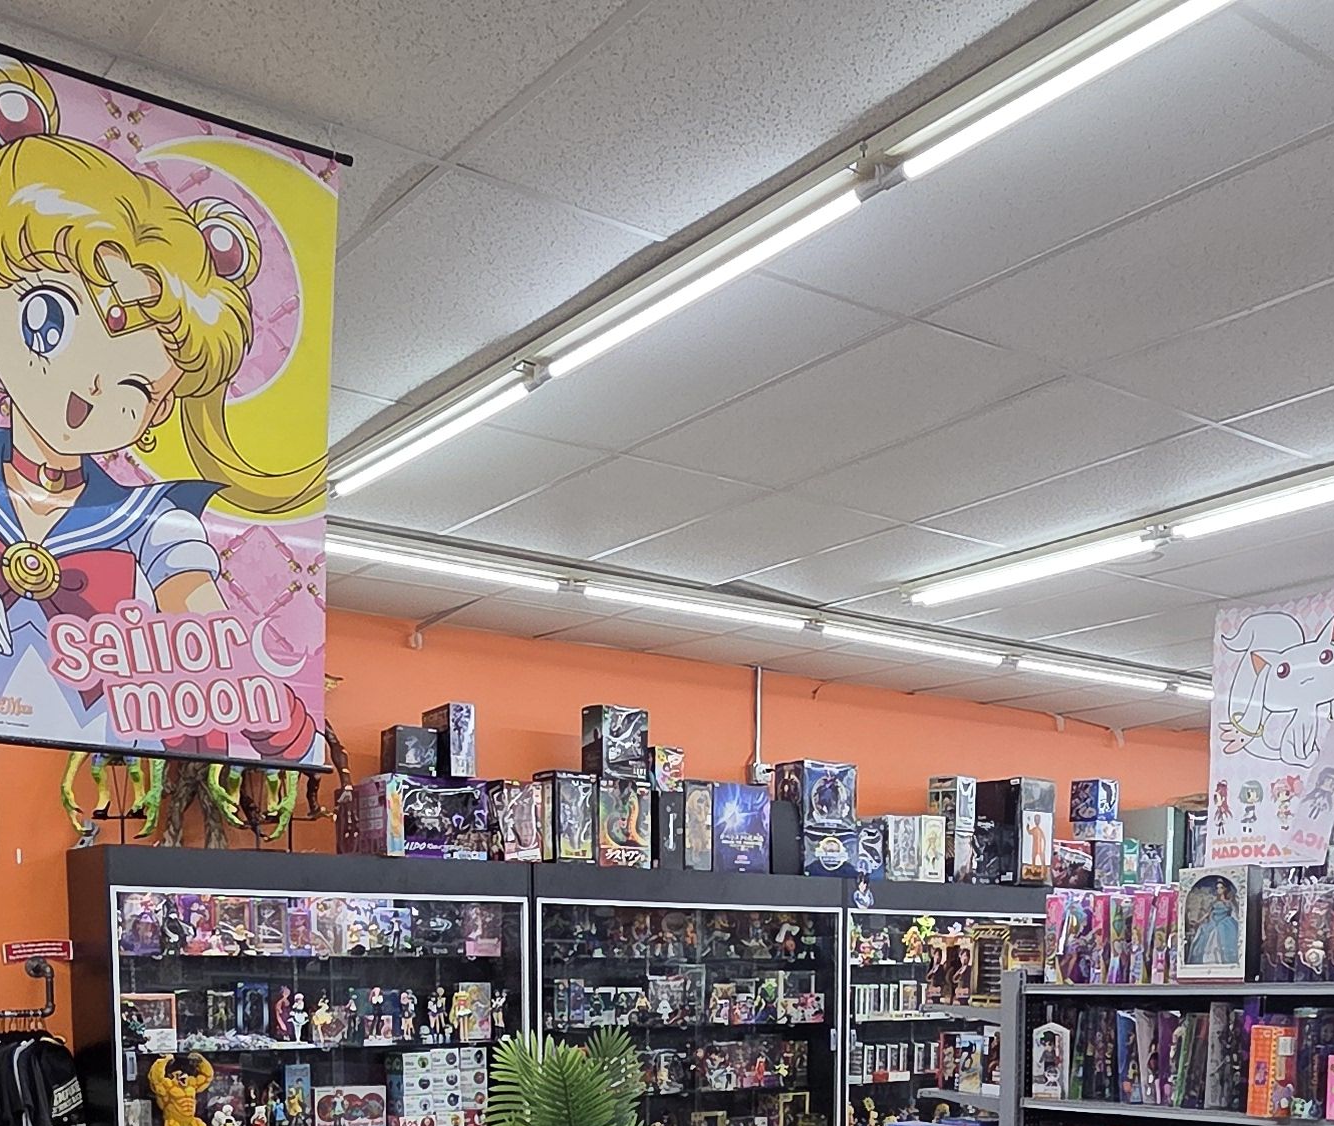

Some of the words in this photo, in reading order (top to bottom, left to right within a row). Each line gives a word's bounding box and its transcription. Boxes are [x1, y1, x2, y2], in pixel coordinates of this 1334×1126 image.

[55, 607, 247, 681] sailor
[111, 675, 281, 732] moon
[1212, 843, 1281, 860] MADOKA
